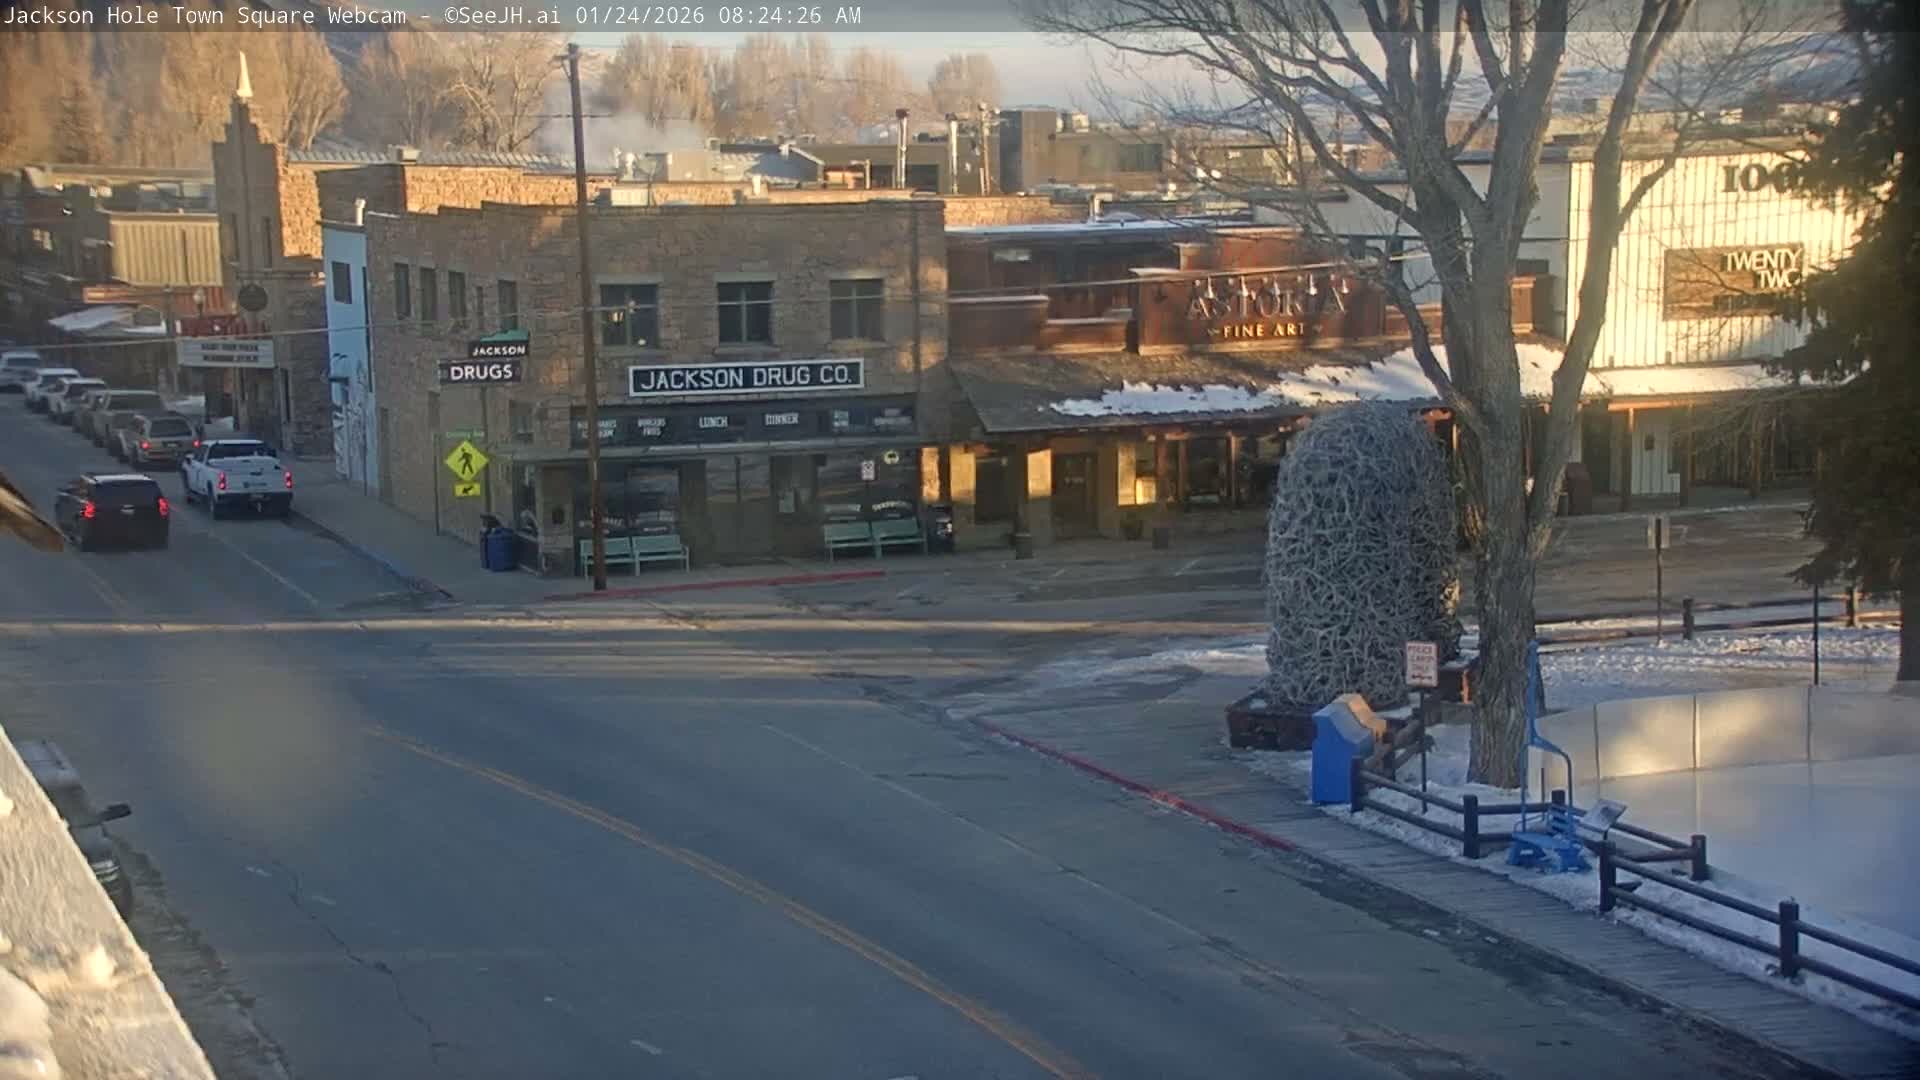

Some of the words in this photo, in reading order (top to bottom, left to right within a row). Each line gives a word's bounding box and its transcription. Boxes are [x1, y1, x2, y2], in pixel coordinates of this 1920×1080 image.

[1726, 248, 1802, 271] TWENTY
[1223, 324, 1264, 338] FINE
[1272, 322, 1305, 336] ART
[472, 345, 526, 357] JACKSON
[450, 364, 513, 381] DRUGS
[640, 368, 743, 390] JACKSON
[753, 366, 811, 387] DRUG
[819, 364, 853, 384] CO.
[699, 416, 728, 428] LUNCH
[764, 412, 799, 426] DINNER
